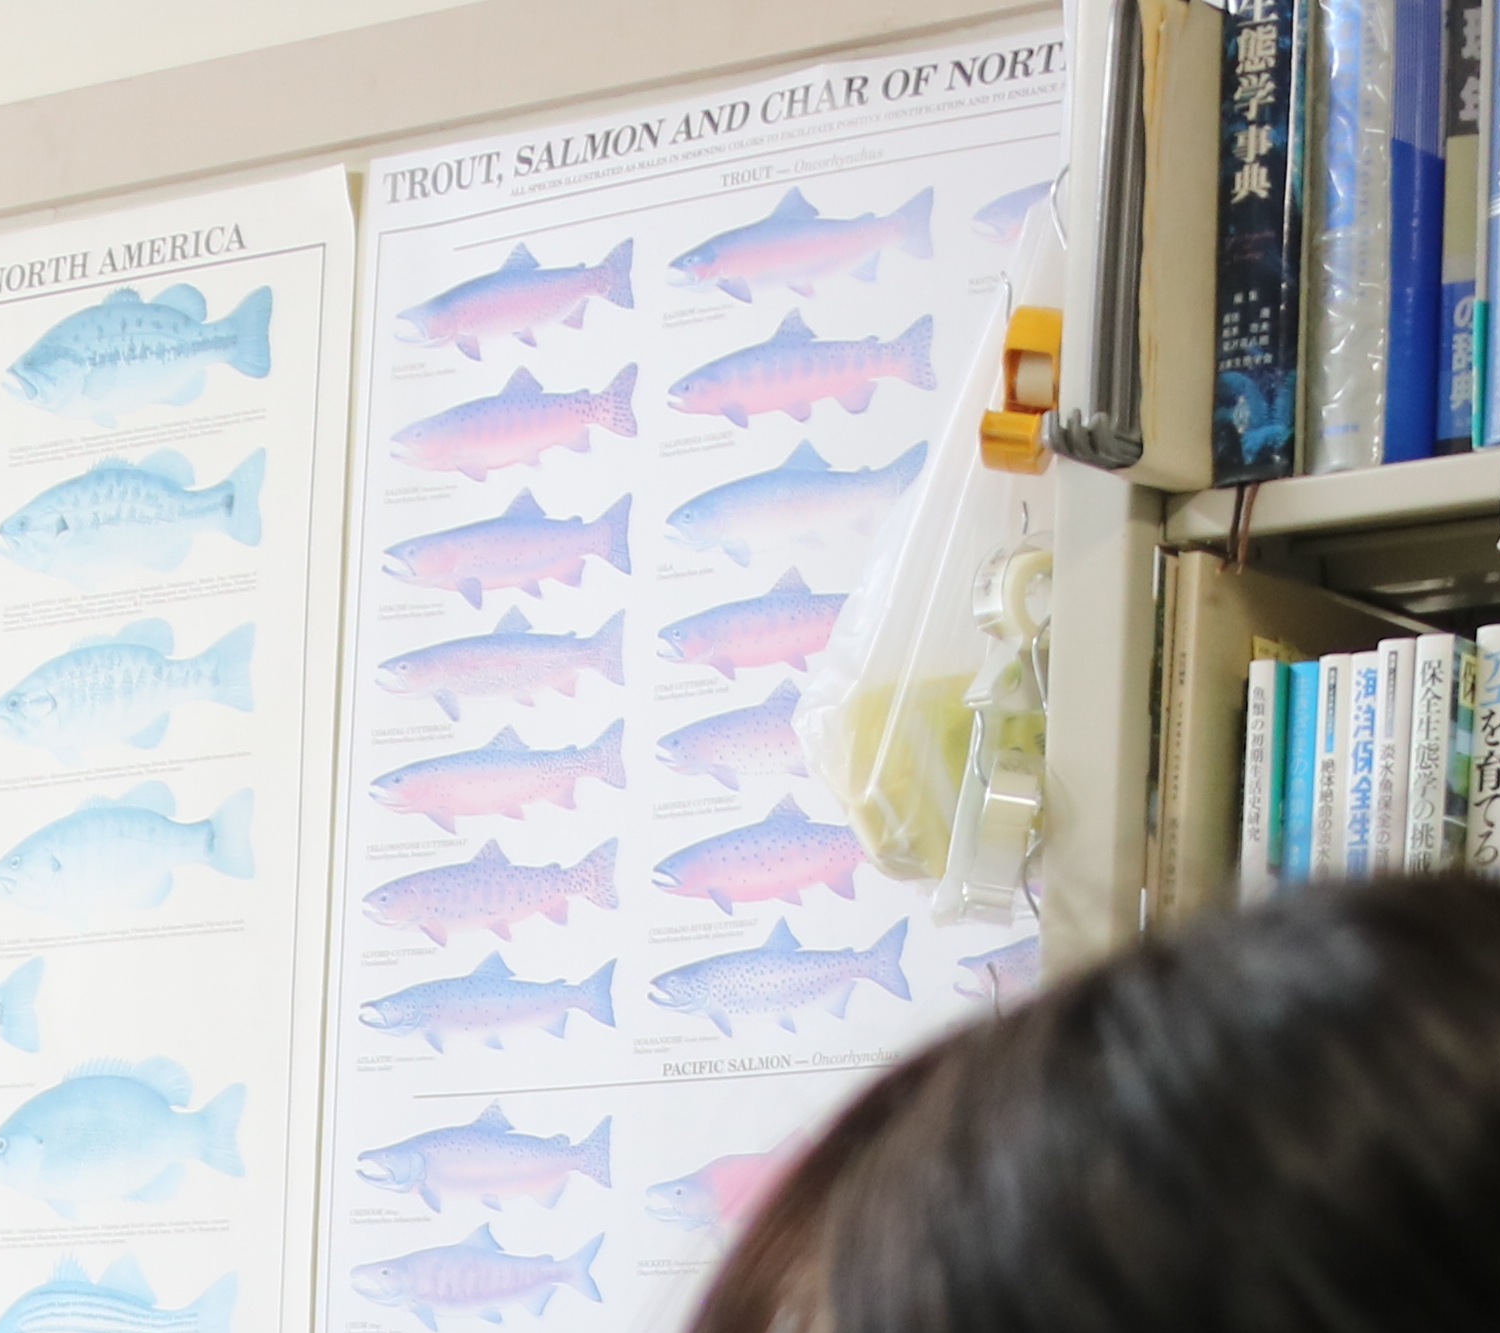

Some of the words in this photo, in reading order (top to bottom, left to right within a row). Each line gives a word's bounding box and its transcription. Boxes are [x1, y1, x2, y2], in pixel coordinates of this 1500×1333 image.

[382, 149, 504, 205] TROUT,
[512, 117, 666, 179] SALMON
[667, 99, 750, 145] AND
[759, 74, 872, 124] CHAR
[881, 63, 939, 102] OF
[943, 41, 1067, 92] NORT
[528, 180, 563, 196] SPECIES
[564, 170, 624, 189] ILLUSTRATED
[680, 145, 728, 164] SPAWNING
[728, 137, 764, 155] COLORS
[765, 134, 779, 144] TO
[779, 125, 834, 143] FACILITATE
[835, 116, 883, 134] POSITIVE
[883, 100, 965, 122] IDENTIFICATION
[966, 95, 990, 108] AND
[991, 92, 1006, 103] TO
[1007, 83, 1058, 99] ENHANCE
[719, 165, 774, 188] TROUT
[792, 144, 886, 176] Oncorhynchus
[96, 221, 248, 278] AMERICA
[661, 1058, 725, 1078] PACIFIC
[728, 1054, 792, 1076] SALMON
[810, 1046, 900, 1069] Oncorhynchus
